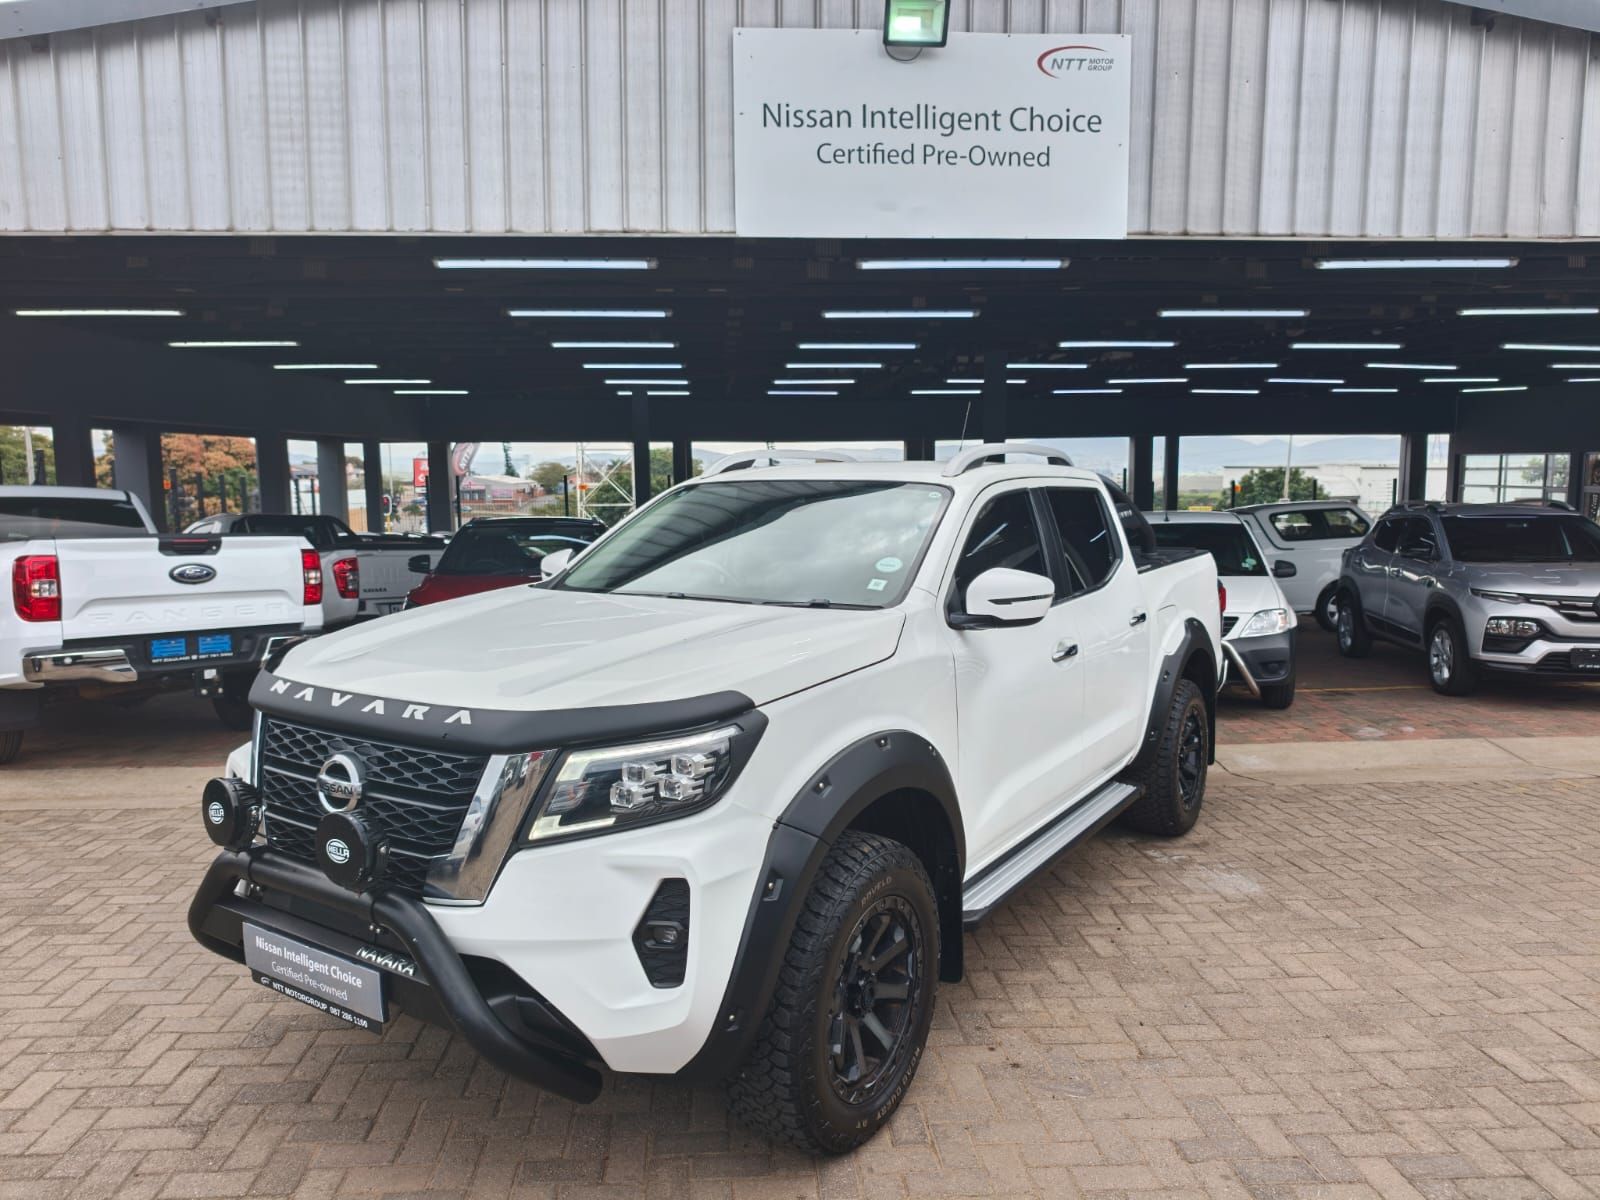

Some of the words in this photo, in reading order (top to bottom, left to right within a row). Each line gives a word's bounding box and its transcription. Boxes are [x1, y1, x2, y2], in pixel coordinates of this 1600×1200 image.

[1051, 58, 1087, 71] NTT
[762, 103, 852, 129] Nissan
[862, 104, 1002, 137] Intelligent
[1010, 106, 1103, 133] Choice
[816, 143, 915, 165] Certified
[923, 144, 1051, 168] Pre-Owned
[270, 679, 473, 725] NAVARA
[209, 807, 225, 817] HELLA
[328, 845, 350, 858] HELLA
[255, 935, 282, 957] Nissan
[283, 947, 329, 976] Intelligent
[330, 965, 363, 988] Choice
[356, 947, 415, 977] NAVARA
[271, 961, 304, 982] Certified
[304, 974, 348, 1001] Pre-owned
[272, 981, 284, 993] NTT
